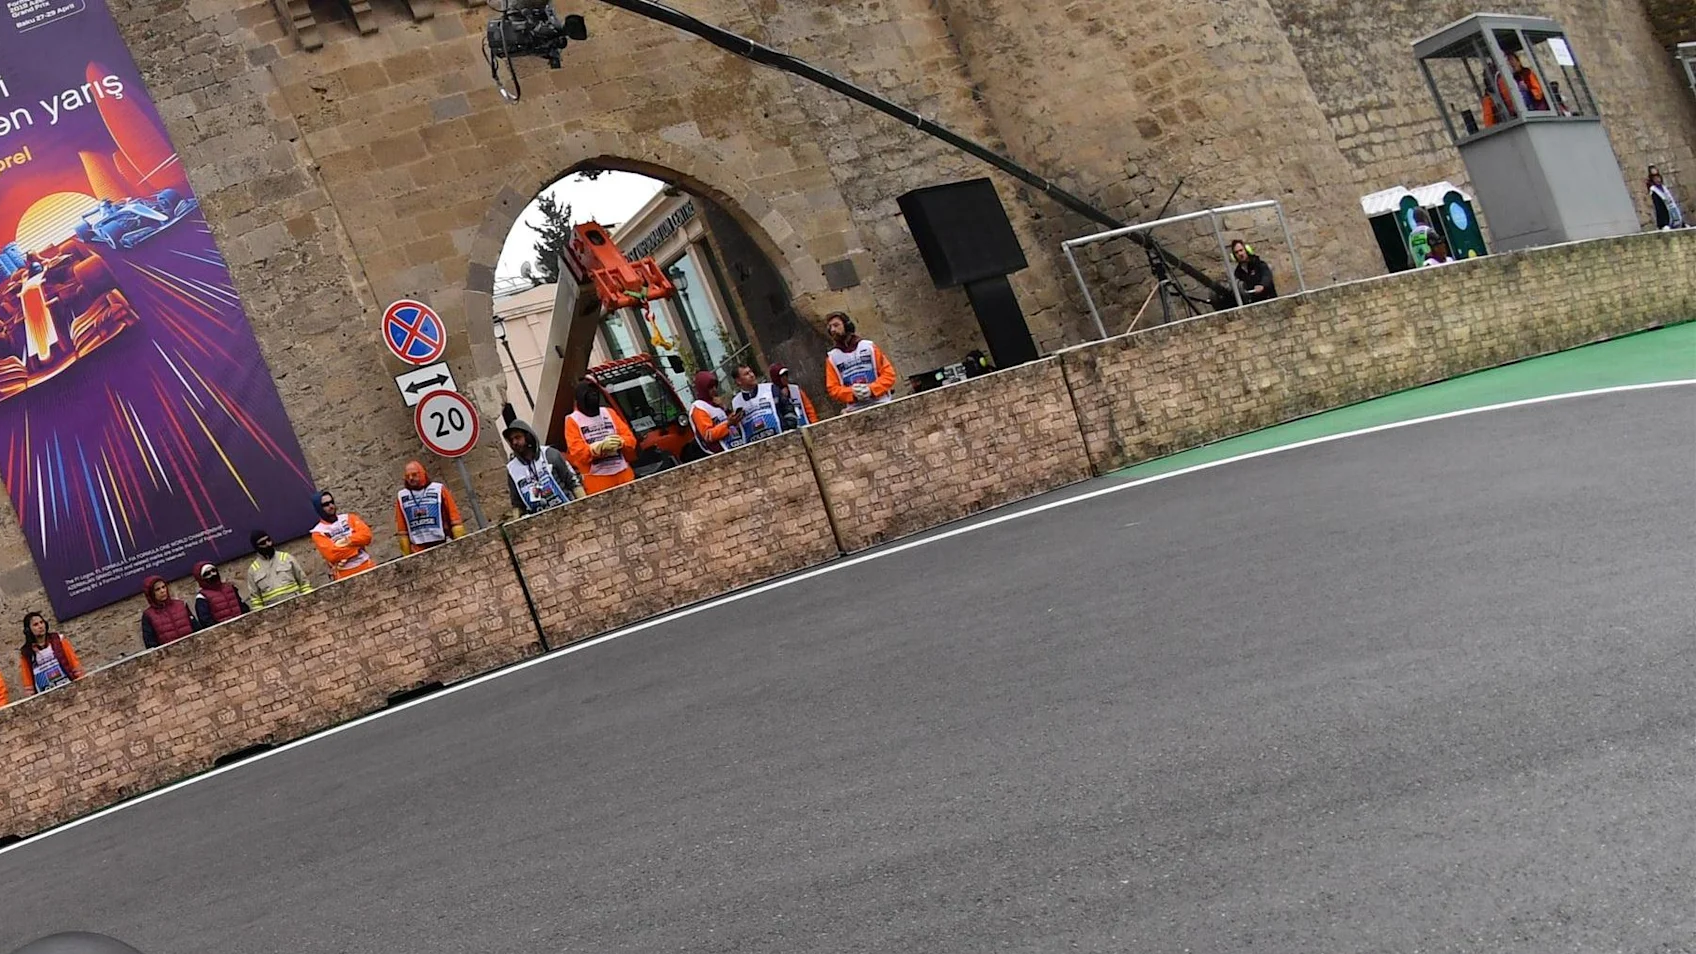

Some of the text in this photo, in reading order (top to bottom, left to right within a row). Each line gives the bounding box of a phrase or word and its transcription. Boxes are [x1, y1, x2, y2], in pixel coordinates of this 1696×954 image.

[12, 6, 35, 18] Grand
[35, 1, 50, 11] Prix
[16, 18, 36, 29] Baku
[57, 3, 75, 14] April
[40, 74, 124, 125] yarış
[430, 407, 465, 438] 20
